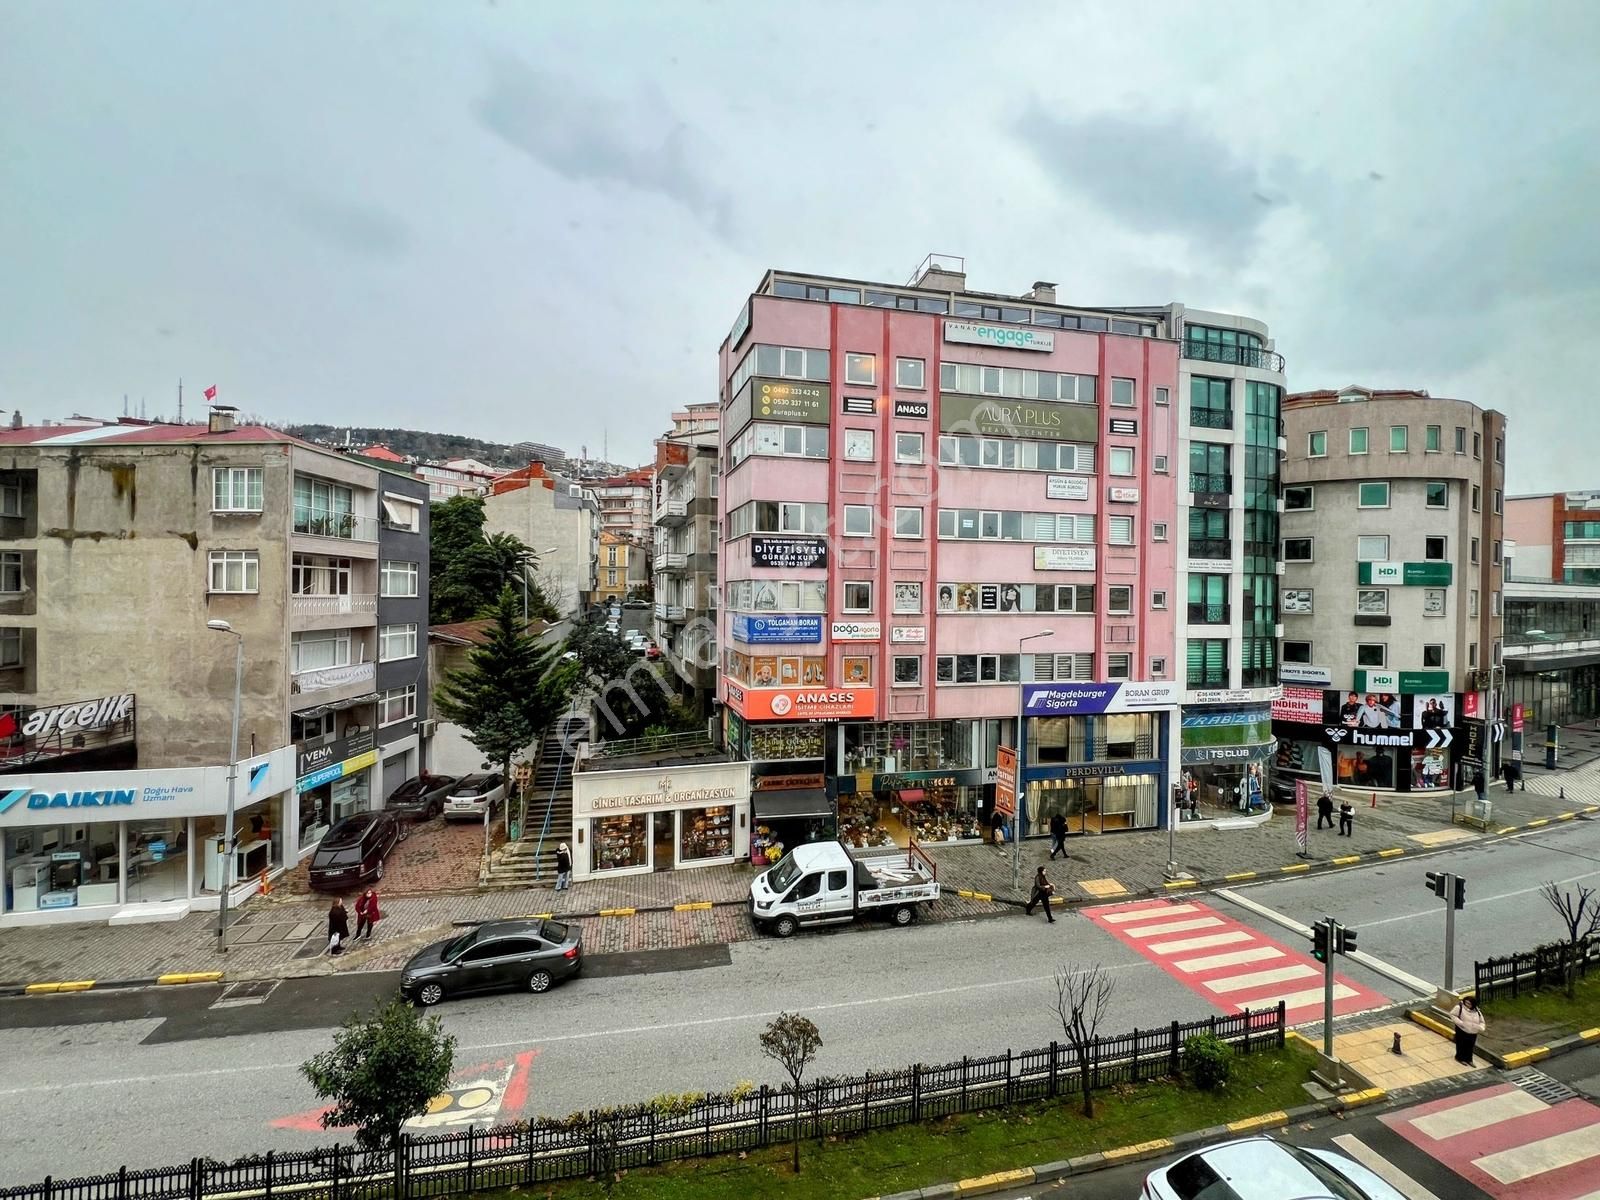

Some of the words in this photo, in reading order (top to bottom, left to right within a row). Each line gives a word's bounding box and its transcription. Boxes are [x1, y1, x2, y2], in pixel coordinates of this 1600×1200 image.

[977, 327, 1033, 346] engage
[791, 399, 802, 407] 337
[896, 404, 927, 415] ANASO
[981, 407, 1022, 424] AURA
[1025, 408, 1061, 426] PLUS
[1024, 429, 1060, 438] CENTER
[755, 543, 826, 555] DİYETİSYEN
[761, 553, 796, 561] GÜRKAN
[797, 554, 819, 562] KURT
[1378, 568, 1398, 576] HDI
[798, 619, 818, 627] BORAN
[1373, 676, 1393, 685] HDI
[795, 692, 855, 704] ANASES
[1048, 690, 1107, 700] Magdeburger
[1125, 690, 1150, 698] BORAN
[1046, 699, 1078, 709] Sigorta
[22, 694, 133, 735] arçelik
[1353, 729, 1414, 746] hummel
[1468, 725, 1478, 757] HOTEL
[1209, 751, 1224, 759] TS
[1225, 749, 1249, 757] CLUB
[1065, 765, 1126, 777] PERDEVILLA
[143, 787, 170, 796] Doğru
[171, 786, 194, 794] Hava
[27, 788, 136, 810] DAIKIN
[625, 794, 663, 807] TASARIM
[664, 795, 673, 804] &
[674, 786, 736, 802] ORGANİZASYON
